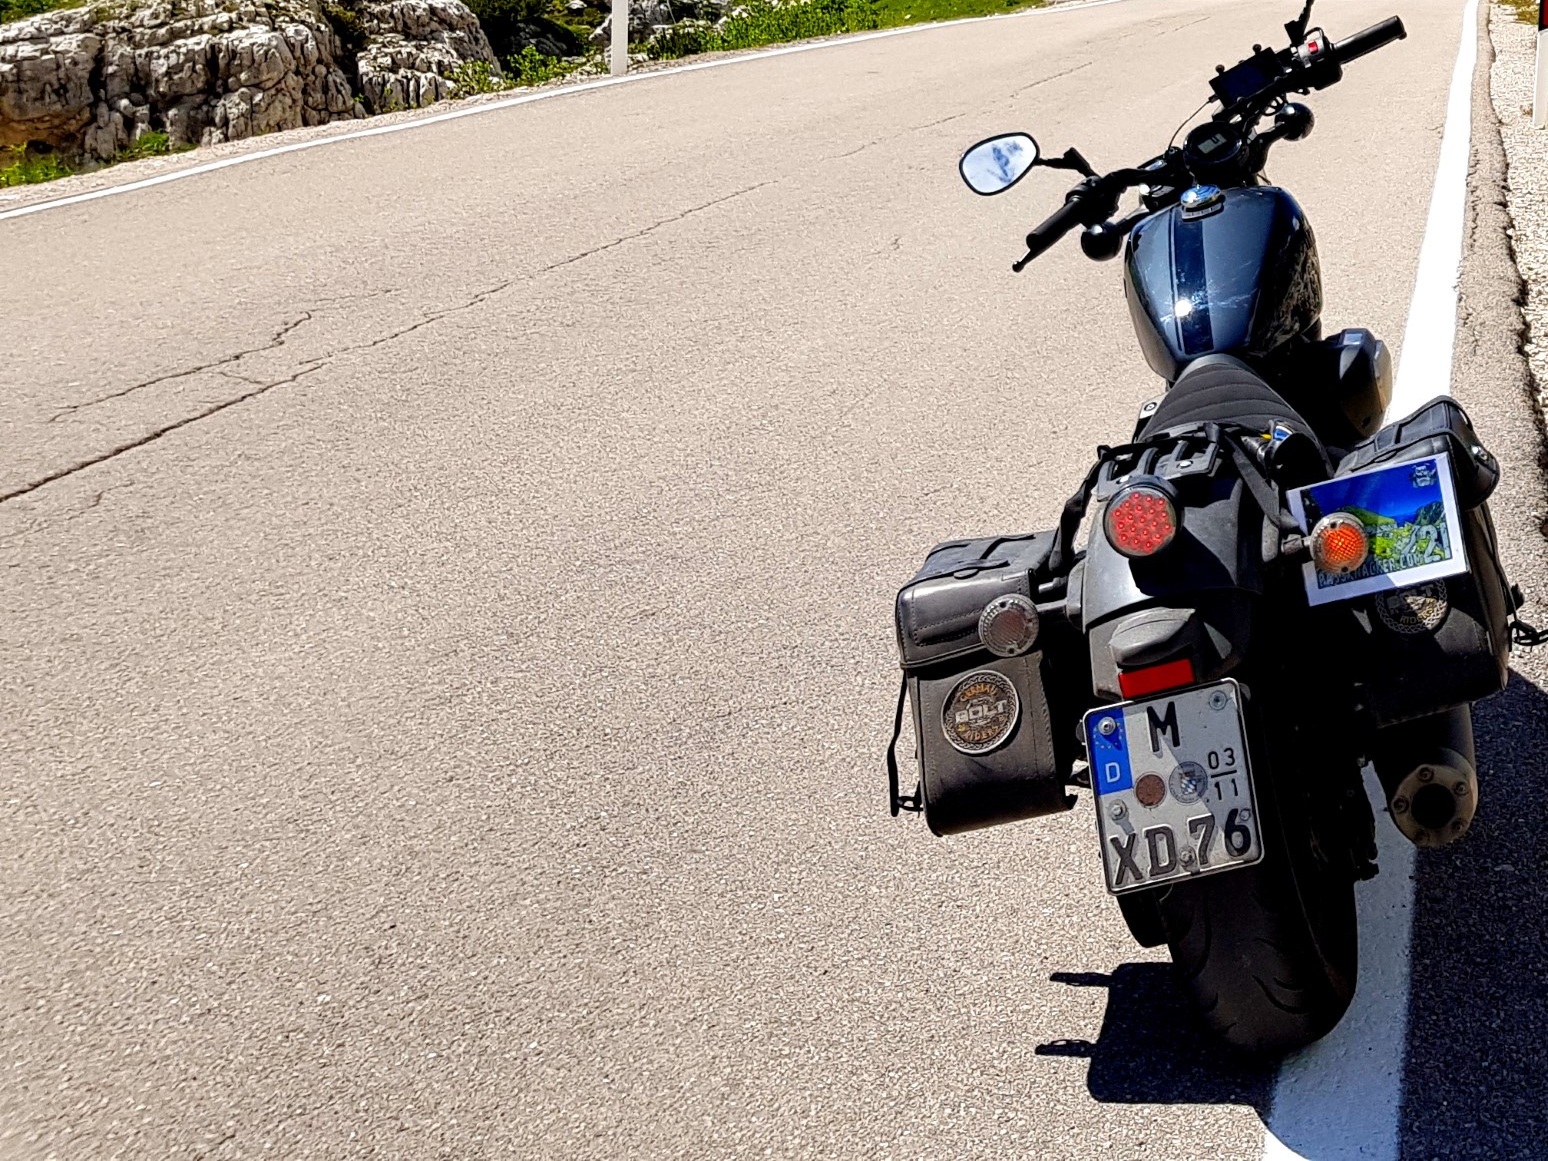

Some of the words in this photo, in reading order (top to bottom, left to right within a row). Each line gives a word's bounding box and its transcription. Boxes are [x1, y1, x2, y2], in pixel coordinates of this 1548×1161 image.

[955, 700, 1008, 723] BOLT
[1146, 701, 1181, 753] M
[1207, 747, 1236, 770] 03
[1105, 761, 1122, 783] D
[1213, 777, 1239, 801] 11
[1109, 825, 1178, 886] XD
[1187, 808, 1252, 866] 76
